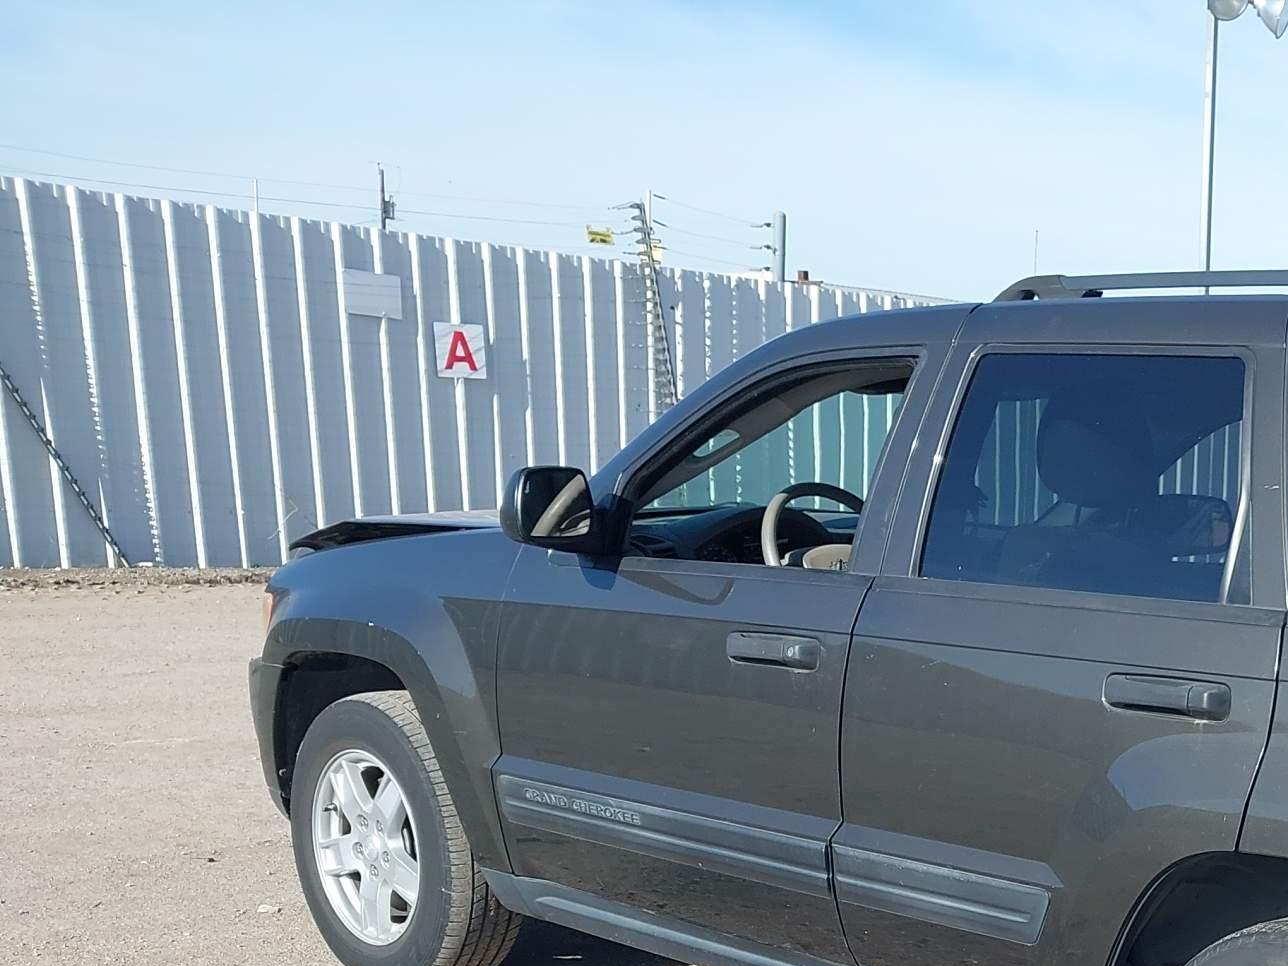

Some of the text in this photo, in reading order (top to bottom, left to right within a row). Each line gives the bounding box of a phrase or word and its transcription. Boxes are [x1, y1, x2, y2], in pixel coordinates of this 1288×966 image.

[445, 331, 478, 371] A
[523, 787, 641, 826] GRAND CHEROKEE
